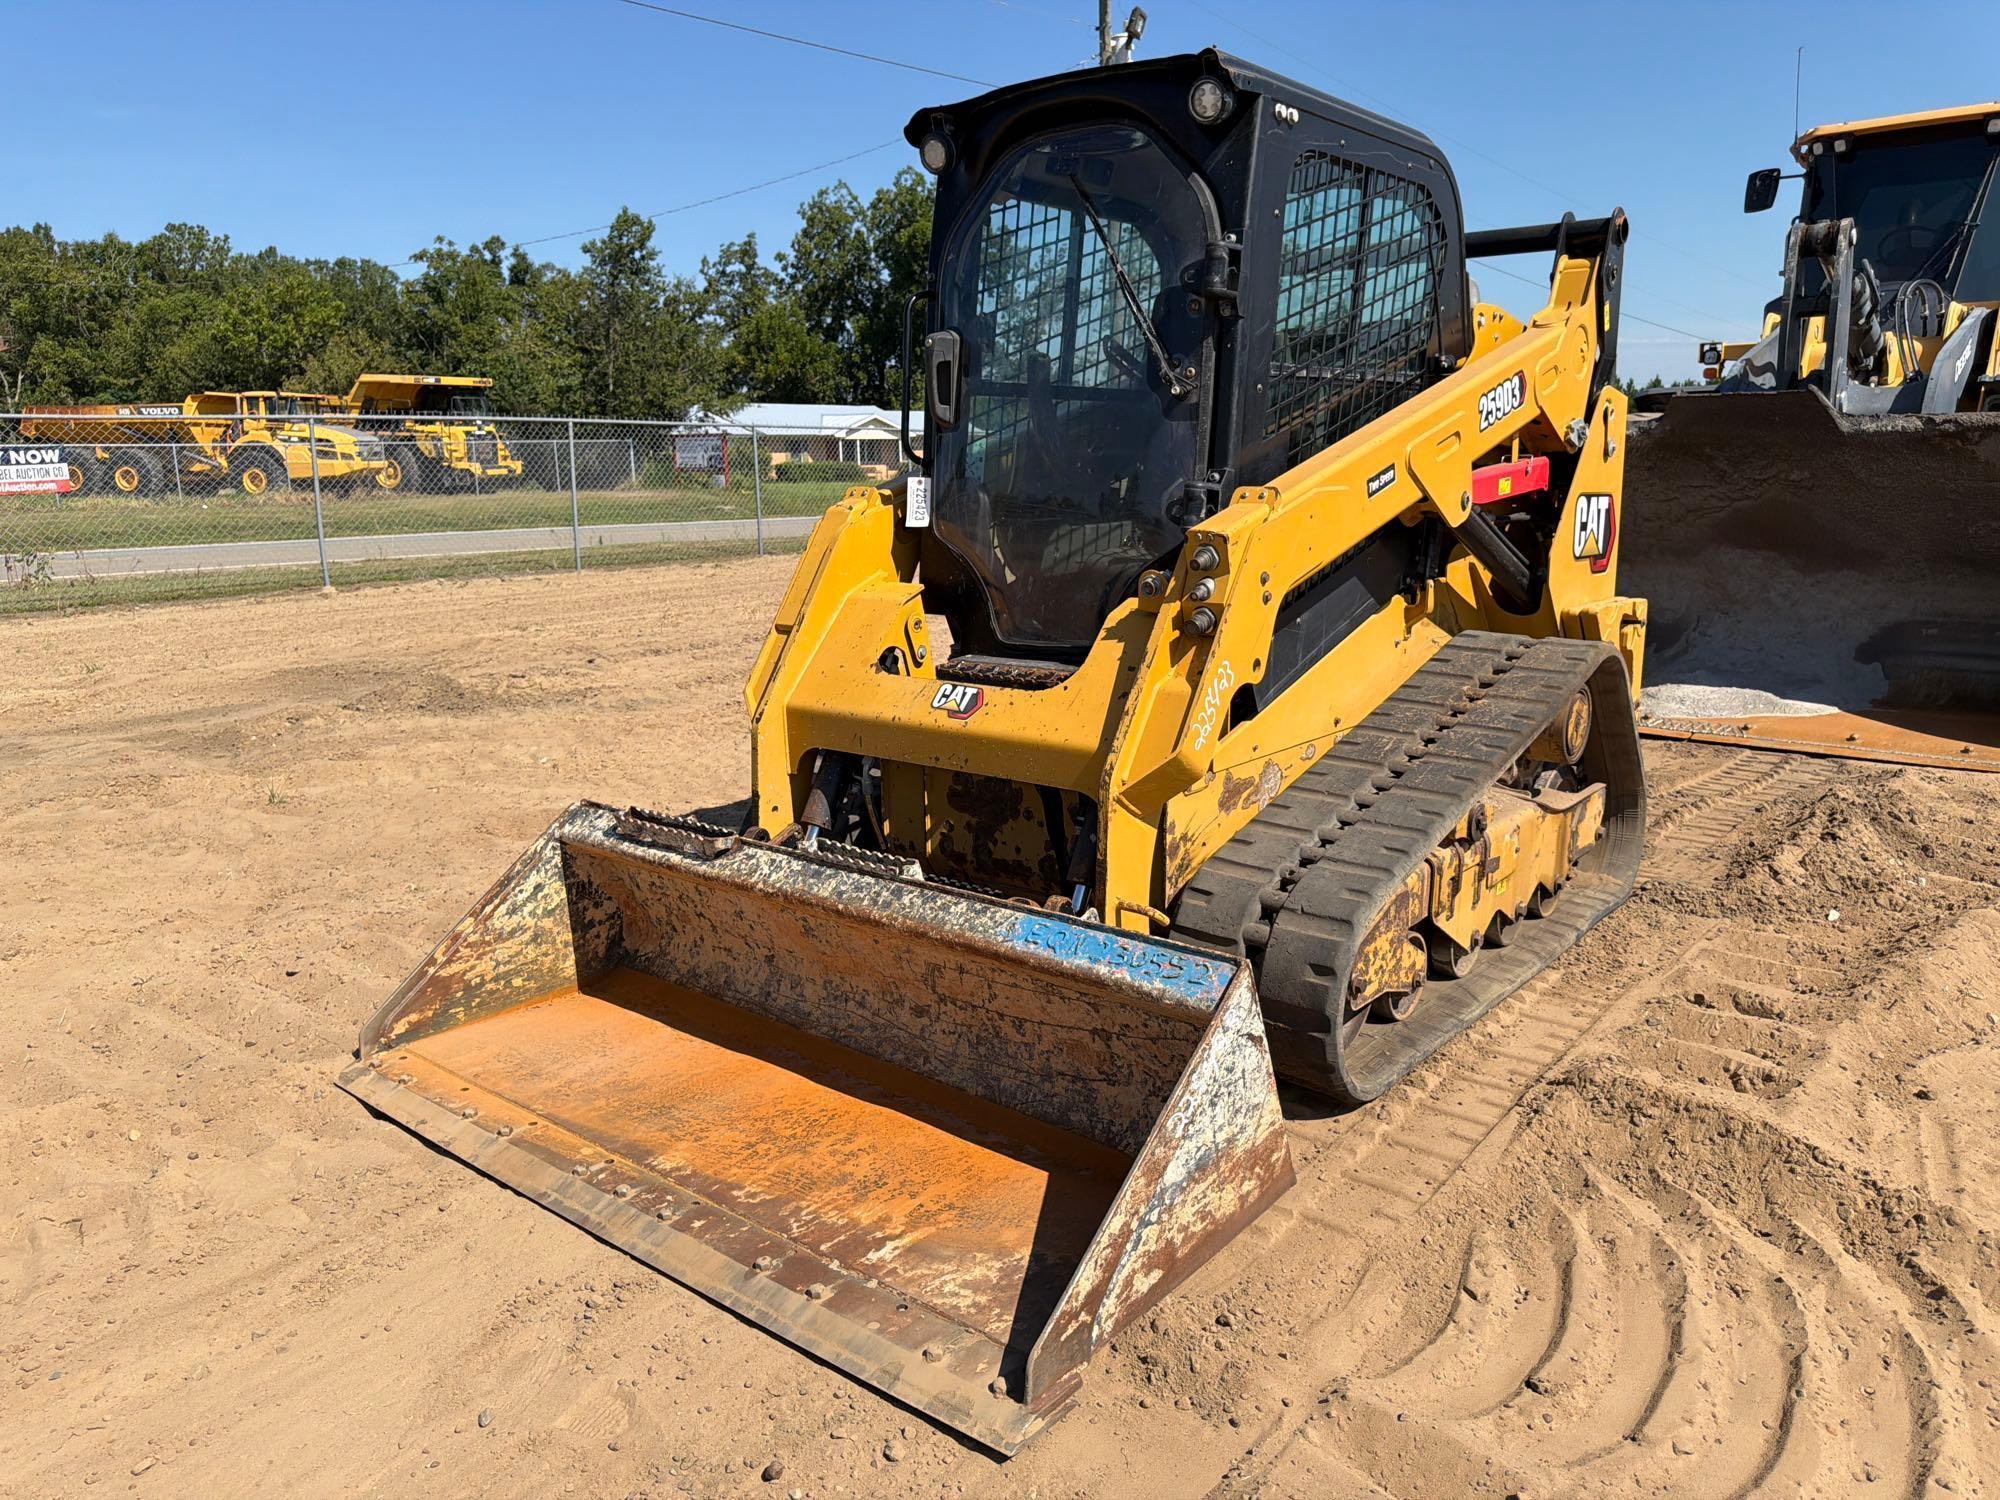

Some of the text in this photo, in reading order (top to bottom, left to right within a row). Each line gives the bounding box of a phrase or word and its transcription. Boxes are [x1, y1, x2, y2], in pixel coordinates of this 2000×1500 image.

[140, 407, 179, 415] VOLVO
[1479, 375, 1520, 431] 259D3
[9, 449, 60, 464] NOW
[16, 466, 51, 480] AUCTION
[914, 488, 927, 521] 225423
[1574, 495, 1610, 558] CAT
[931, 683, 978, 712] CAT
[1192, 660, 1235, 751] 225423
